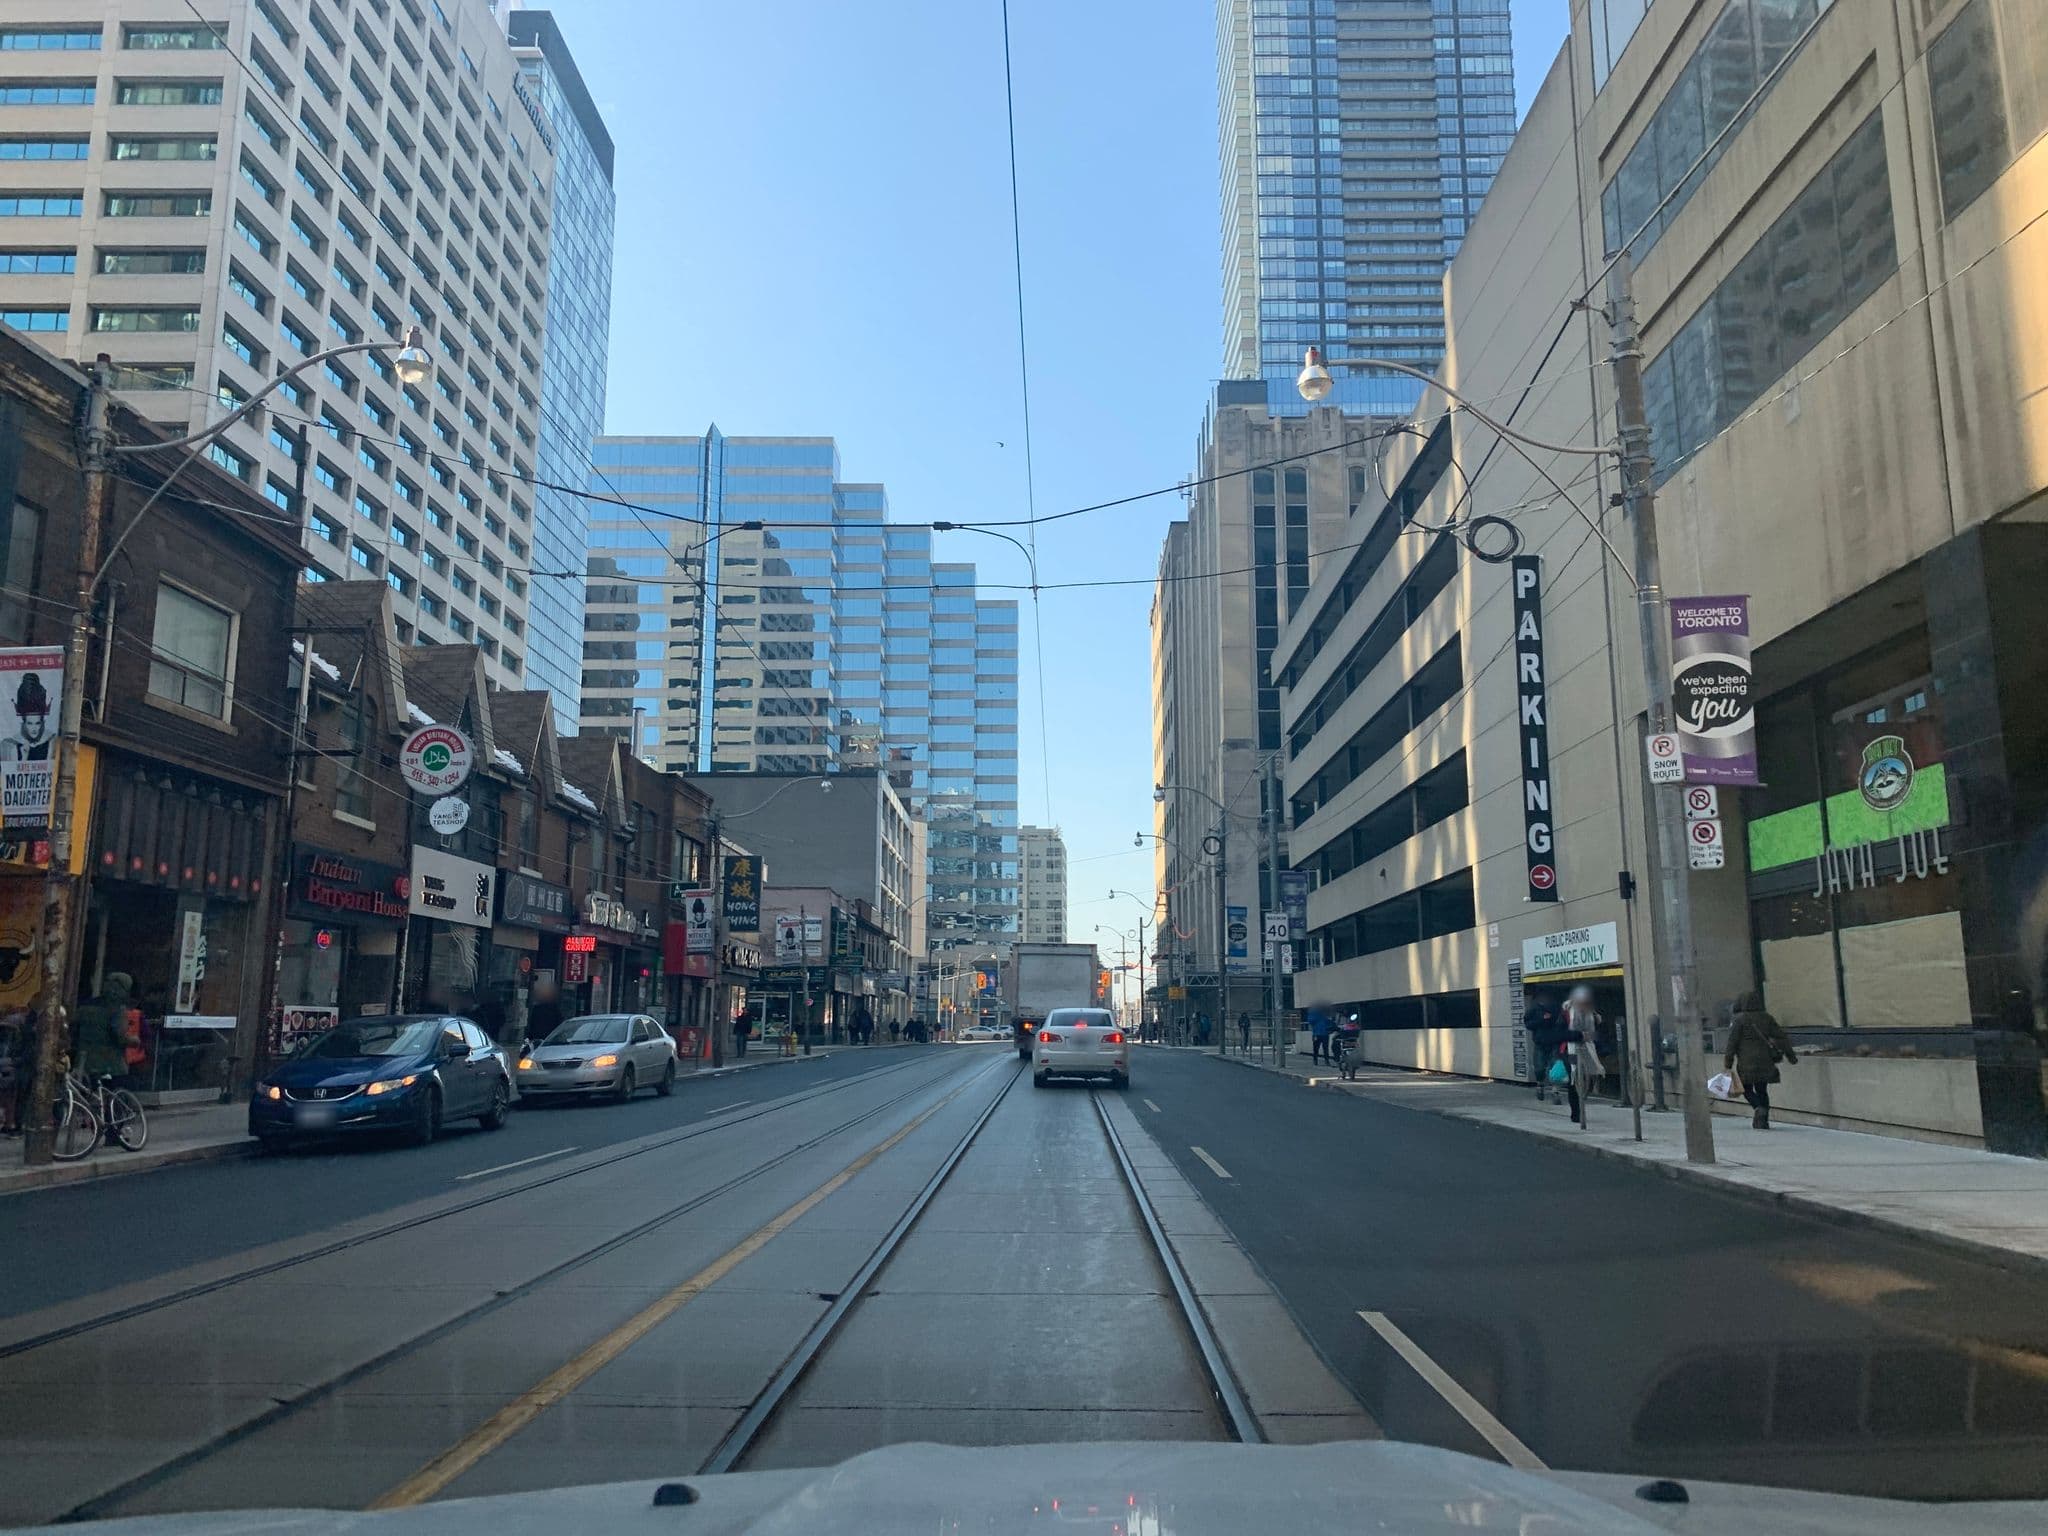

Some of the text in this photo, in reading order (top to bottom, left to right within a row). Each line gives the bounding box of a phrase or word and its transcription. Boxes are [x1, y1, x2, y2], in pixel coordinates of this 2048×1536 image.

[1677, 607, 1741, 617] WELCOME TO
[1677, 616, 1742, 628] TORONTO
[1682, 675, 1747, 686] we've been
[1691, 684, 1747, 696] expecting
[1516, 568, 1551, 853] PARKING
[1691, 697, 1741, 724] you
[1654, 760, 1678, 769] SNOW
[1653, 769, 1681, 779] ROUTE
[1813, 840, 1876, 898] JAVA
[727, 901, 757, 911] HONG
[1267, 924, 1288, 937] 40
[566, 937, 579, 945] ALL
[1545, 928, 1590, 948] PUBLIC PARKING
[1534, 944, 1604, 970] ENTRANCE ONLY
